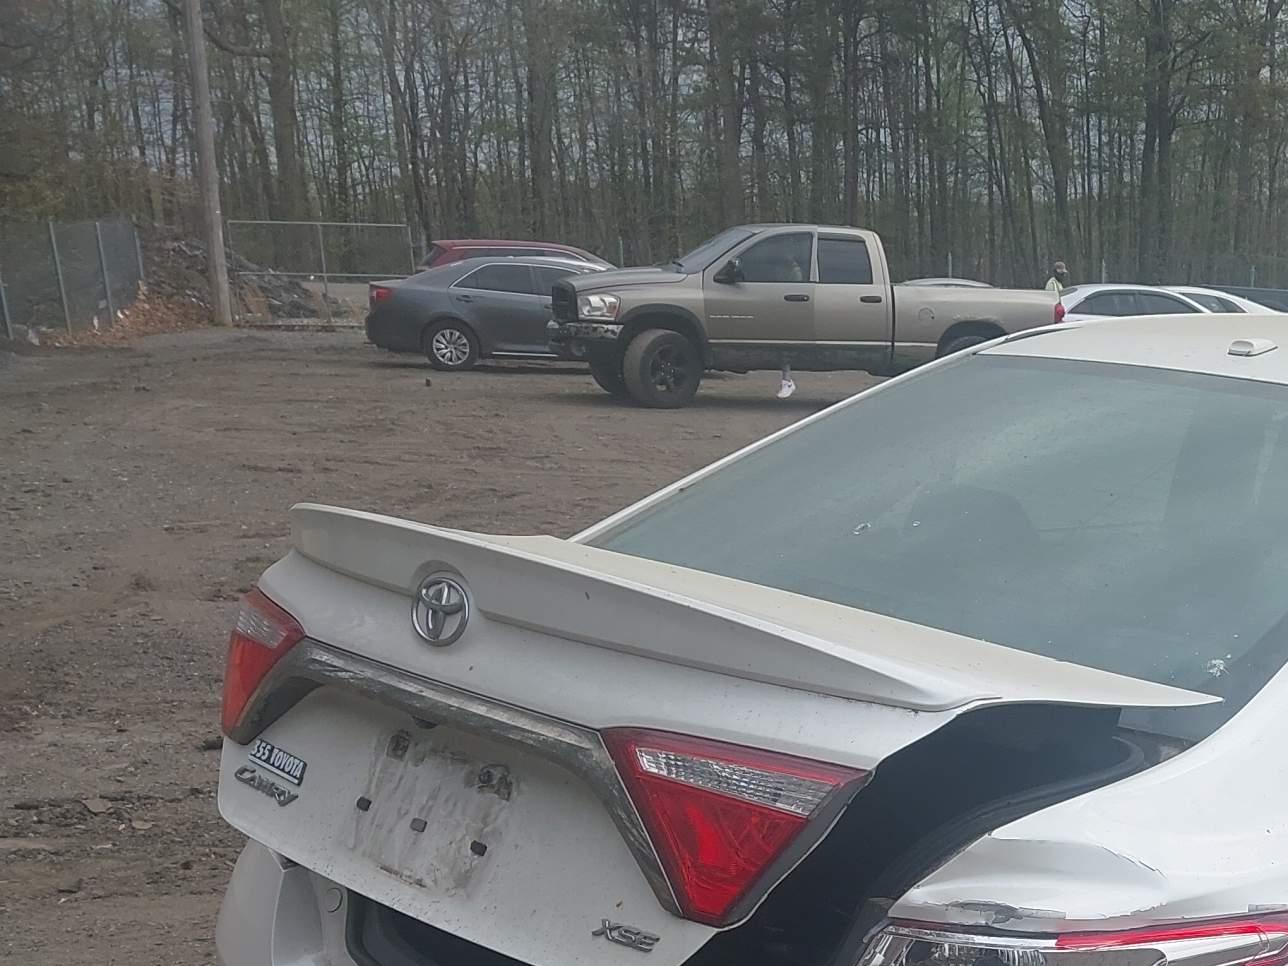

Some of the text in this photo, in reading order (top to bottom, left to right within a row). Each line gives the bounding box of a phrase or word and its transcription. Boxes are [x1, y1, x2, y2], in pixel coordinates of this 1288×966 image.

[250, 740, 304, 778] 355 TOYOTA
[592, 919, 660, 952] XSE
